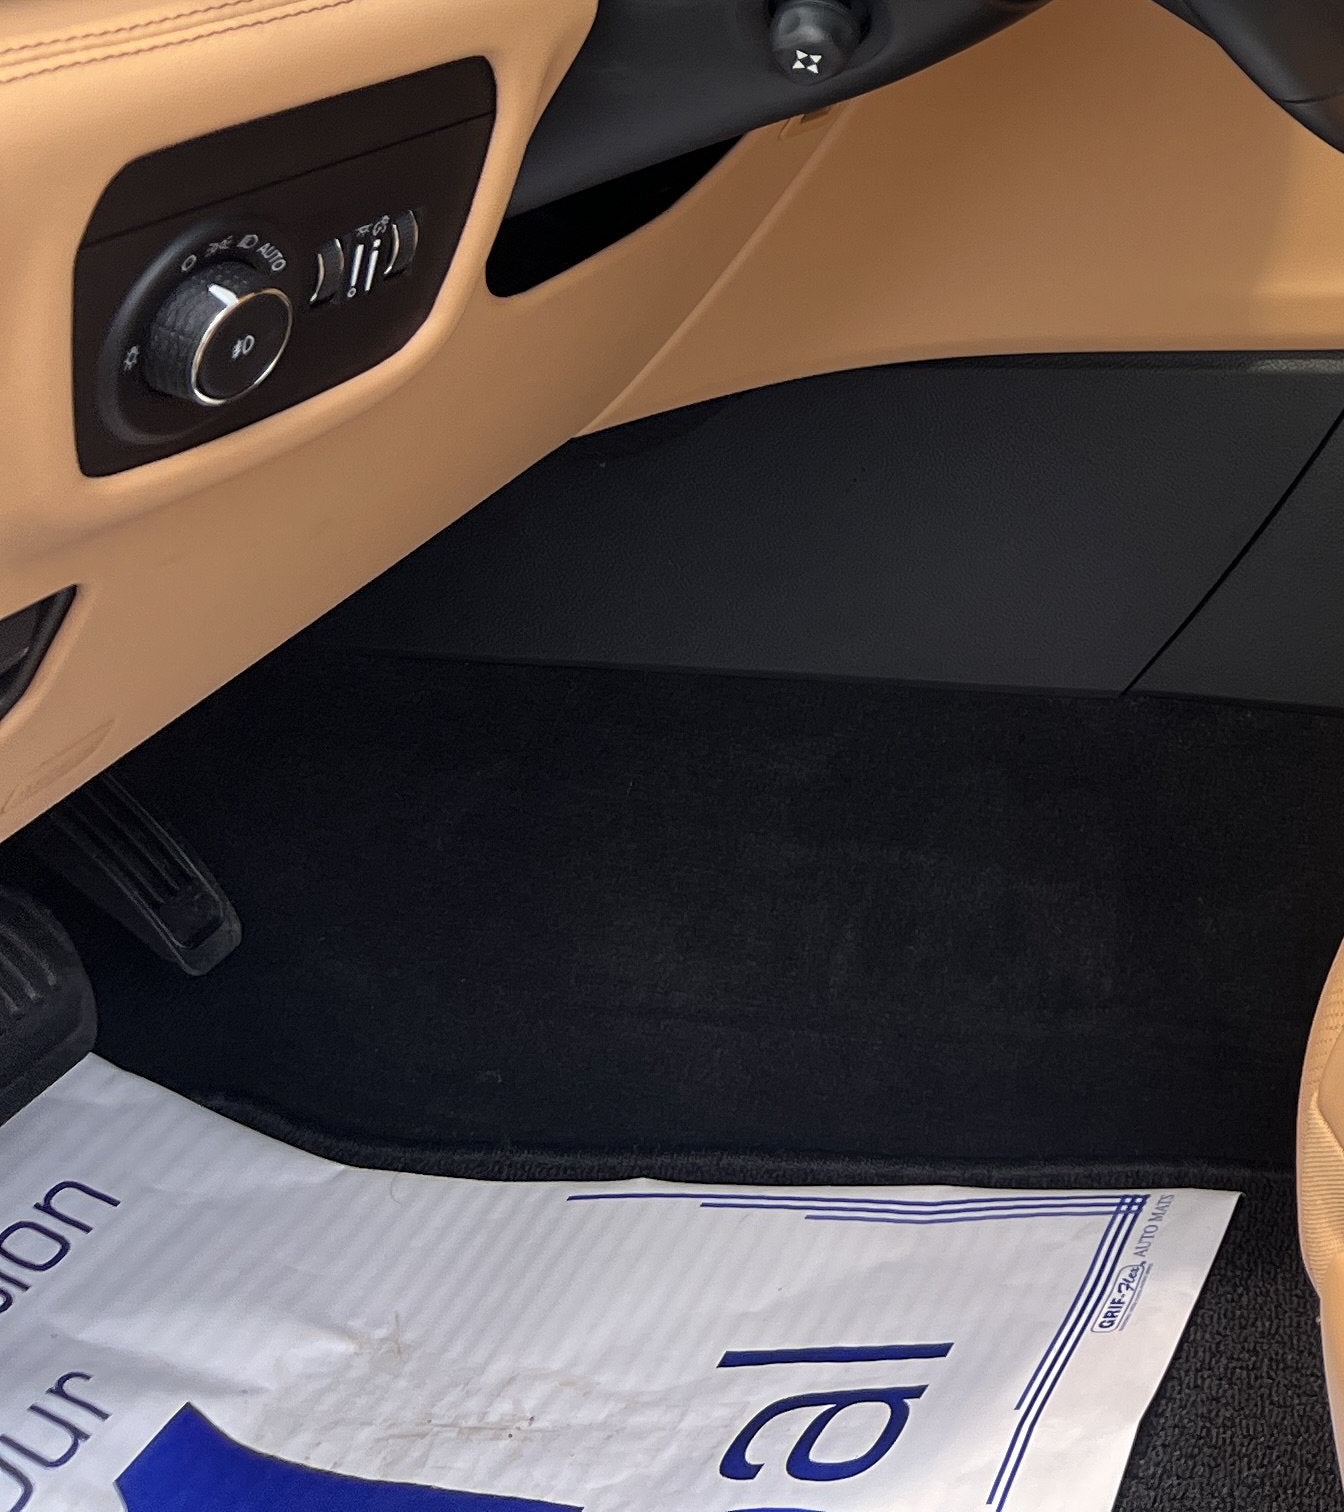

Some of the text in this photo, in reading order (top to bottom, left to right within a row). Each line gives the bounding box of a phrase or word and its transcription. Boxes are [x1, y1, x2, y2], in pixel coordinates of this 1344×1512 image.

[256, 241, 287, 272] AUTO
[0, 1180, 122, 1315] ion
[1133, 1224, 1159, 1258] AUTO
[1147, 1194, 1175, 1222] MATS
[716, 1342, 955, 1512] al
